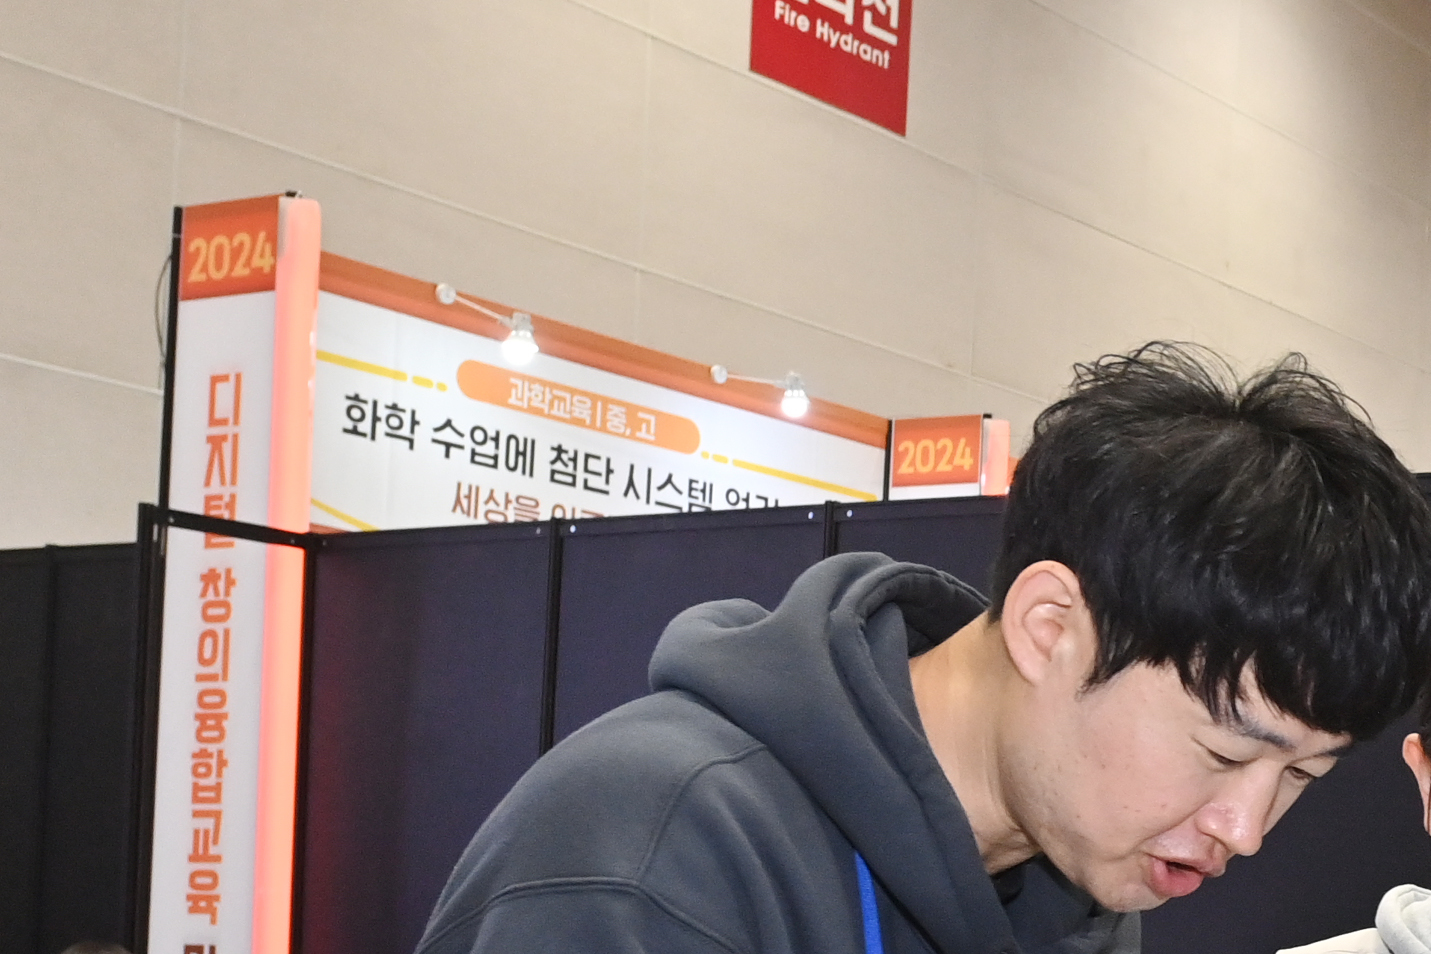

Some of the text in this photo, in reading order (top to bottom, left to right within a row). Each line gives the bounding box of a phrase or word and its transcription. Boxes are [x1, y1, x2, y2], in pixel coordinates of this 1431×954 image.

[774, 0, 810, 32] Fire
[816, 18, 890, 69] Hydrant
[187, 231, 276, 283] 2024
[508, 377, 592, 426] 과학교육
[606, 403, 632, 437] 중,
[636, 411, 656, 441] 고
[203, 371, 243, 550] 디지털
[342, 392, 714, 513] 화학 수업에 첨단 시스템
[898, 437, 974, 475] 2024
[451, 481, 541, 523] 세상을
[185, 566, 236, 926] 창의융합교육
